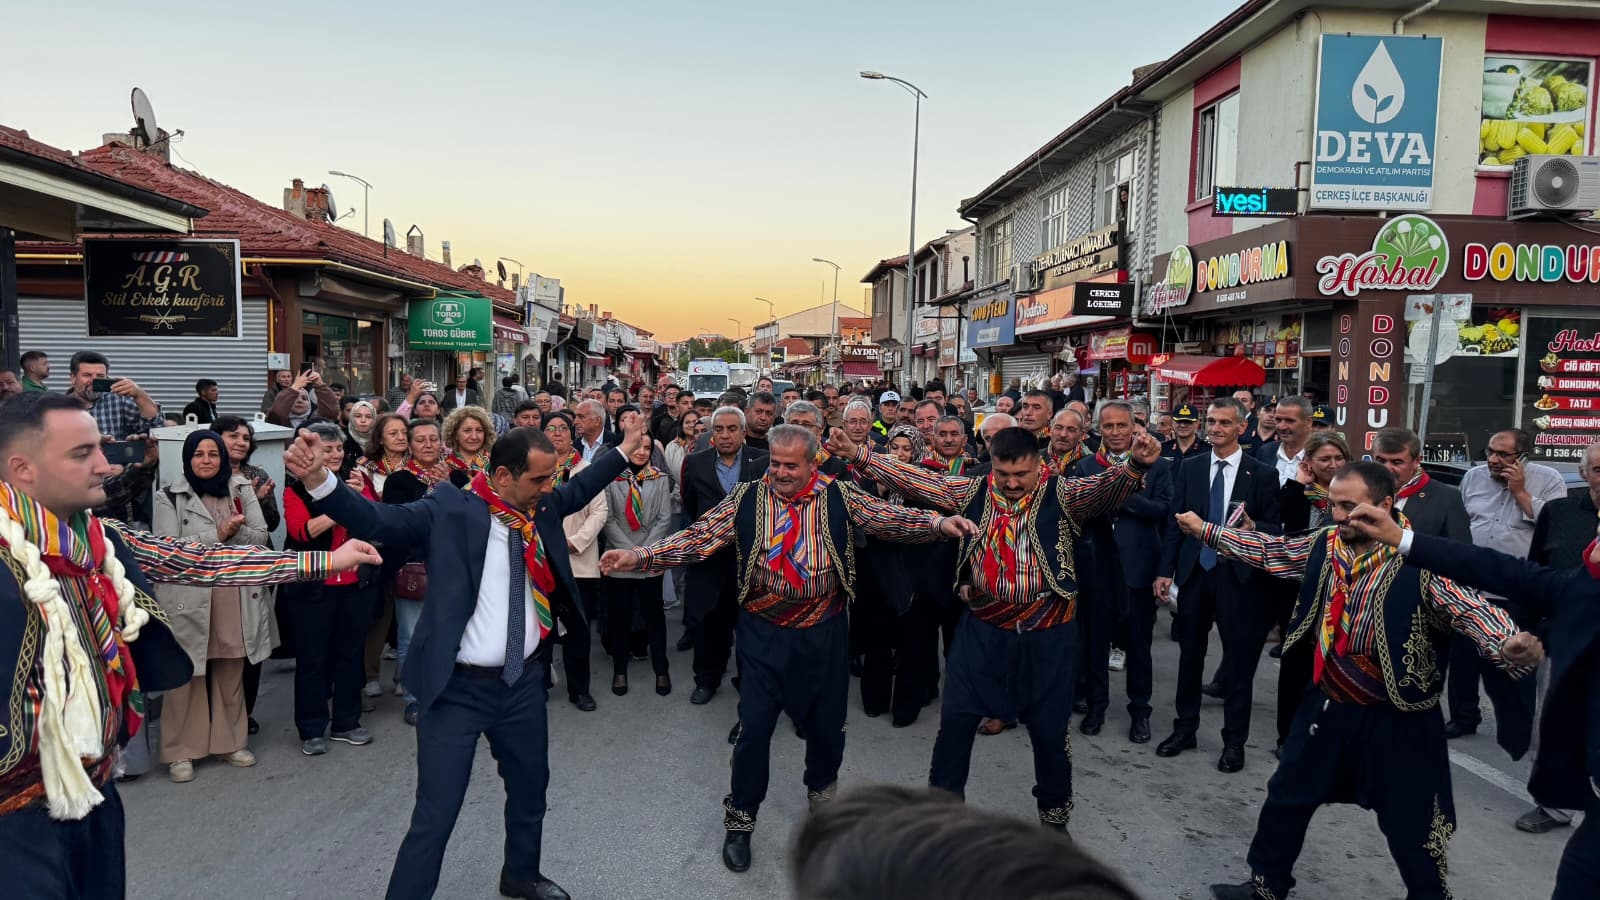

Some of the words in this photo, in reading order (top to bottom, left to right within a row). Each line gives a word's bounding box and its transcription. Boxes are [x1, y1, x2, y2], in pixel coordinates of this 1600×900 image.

[1316, 130, 1431, 165] DEVA
[1316, 166, 1363, 175] DEMOKRASİ
[1376, 167, 1400, 175] ATILIM
[1401, 168, 1431, 176] PARTİSİ
[1315, 190, 1350, 203] ÇERKEŞ
[1352, 188, 1371, 204] İLÇE
[1374, 190, 1428, 205] BAŞKANLIĞI
[1196, 239, 1288, 293] DONDURMA
[120, 264, 202, 293] A.G.R
[1320, 254, 1439, 294] Hasbal
[102, 291, 128, 307] Stil
[130, 292, 170, 307] Erkek
[172, 292, 226, 312] kuaförü
[422, 328, 449, 338] TOROS
[450, 327, 477, 339] GÜBRE
[852, 348, 879, 356] AYDIN
[1558, 379, 1600, 390] DONDURM
[1569, 398, 1592, 409] TATLI
[1535, 431, 1553, 446] AİLE
[1545, 448, 1552, 457] 0
[1553, 448, 1570, 458] 536
[1571, 448, 1585, 458] 46
